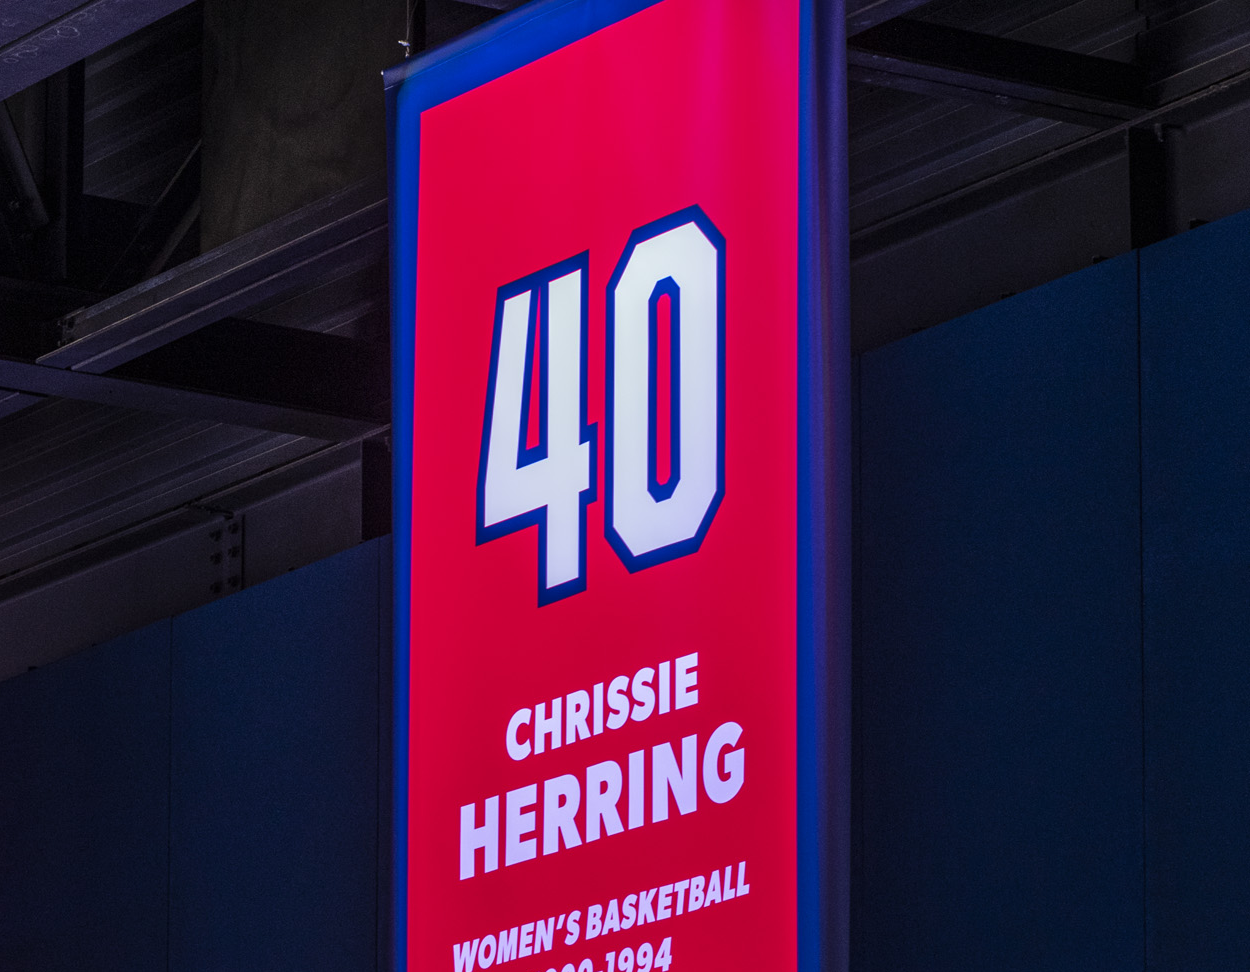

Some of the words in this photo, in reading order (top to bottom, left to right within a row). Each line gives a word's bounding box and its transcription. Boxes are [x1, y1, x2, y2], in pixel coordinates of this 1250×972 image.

[475, 203, 726, 609] 40
[505, 651, 699, 761] CHRISSIE
[459, 721, 745, 881] HERRING
[585, 860, 750, 940] BASKETBALL
